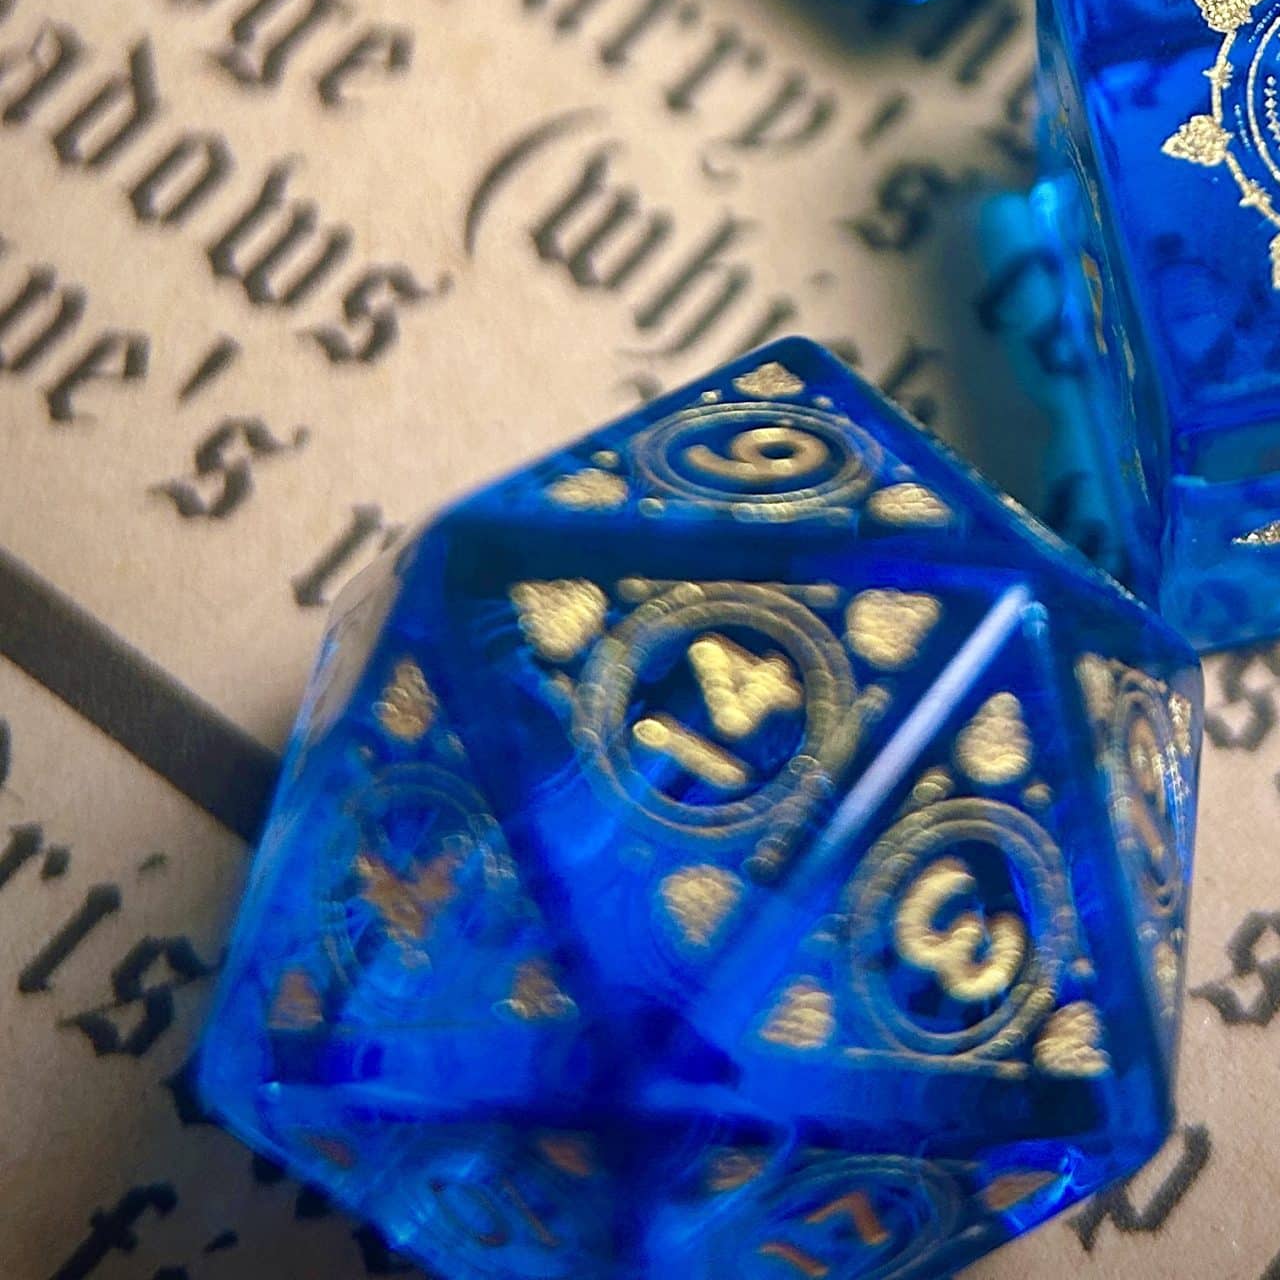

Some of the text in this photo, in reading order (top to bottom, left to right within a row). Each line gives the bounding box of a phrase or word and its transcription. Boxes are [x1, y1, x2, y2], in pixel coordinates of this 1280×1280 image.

[0, 10, 456, 372] adows
[632, 631, 806, 789] 14
[894, 854, 1028, 1004] 3
